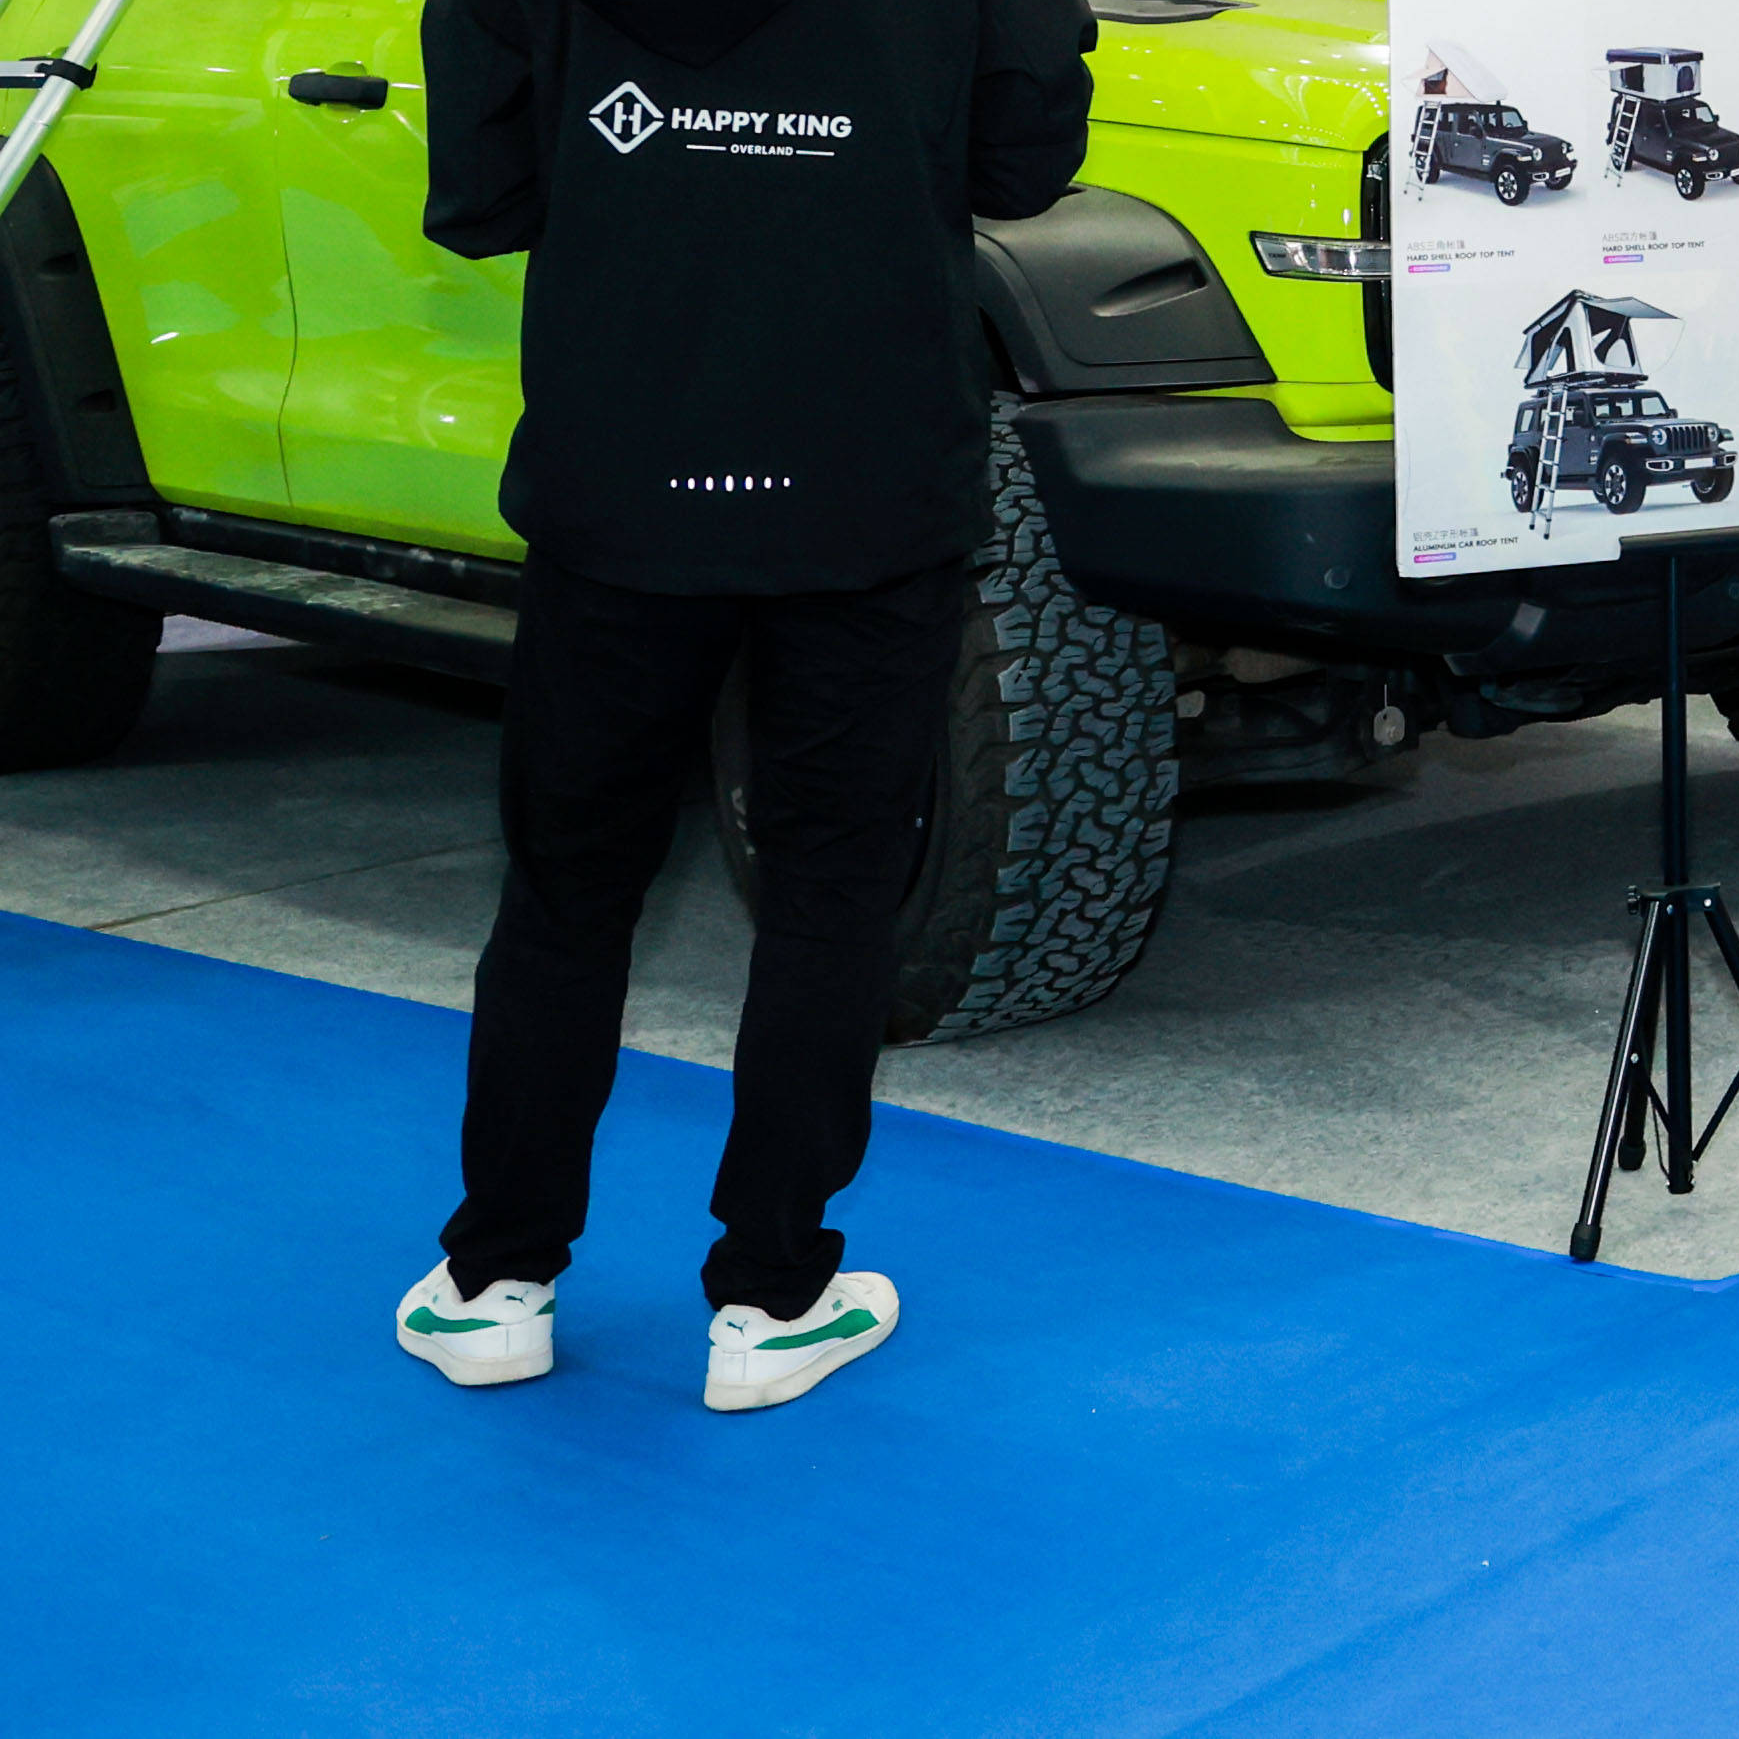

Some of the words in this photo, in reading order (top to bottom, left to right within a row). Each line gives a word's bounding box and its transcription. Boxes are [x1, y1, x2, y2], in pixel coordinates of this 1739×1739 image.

[671, 107, 771, 135] HAPPY
[776, 113, 853, 139] KING
[730, 143, 794, 157] OVERLAND
[1602, 245, 1624, 253] HARD
[1625, 244, 1646, 252] SHELL
[1688, 240, 1705, 248] TENT
[1407, 254, 1429, 262] HARD
[1431, 253, 1453, 261] SHELL
[1455, 252, 1477, 260] ROOF
[1413, 543, 1456, 552] ALUMINUM
[1476, 538, 1498, 547] ROOF
[1500, 536, 1519, 544] TENT
